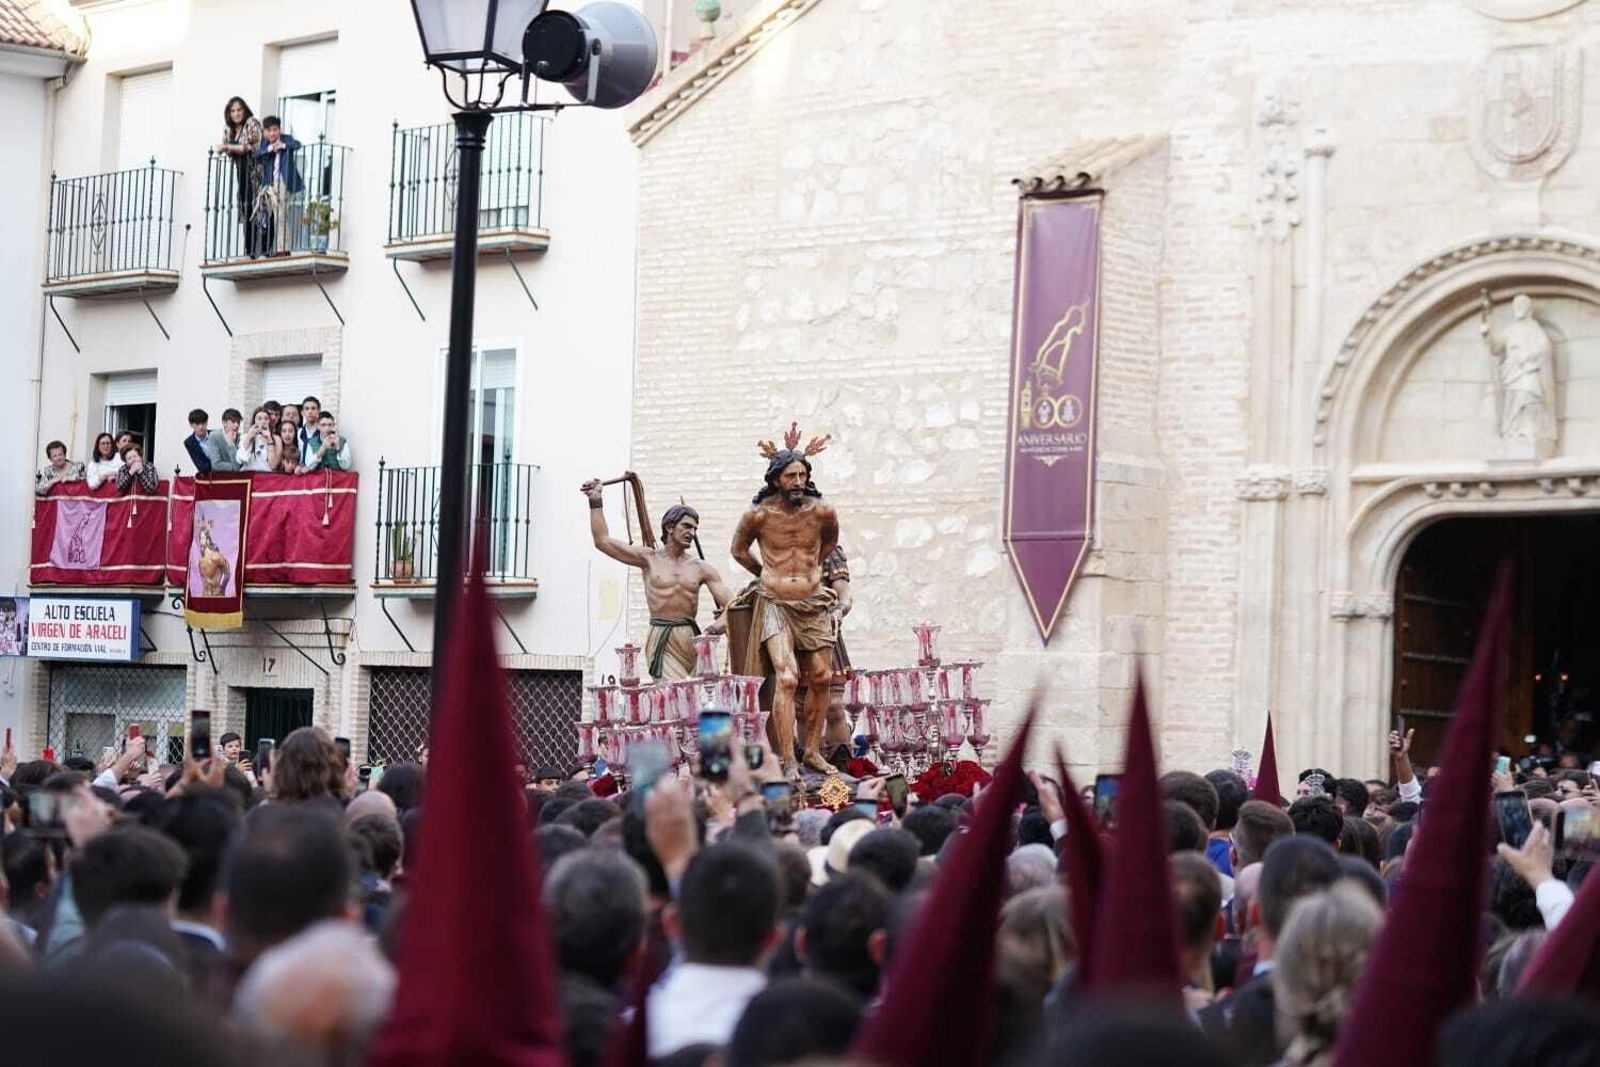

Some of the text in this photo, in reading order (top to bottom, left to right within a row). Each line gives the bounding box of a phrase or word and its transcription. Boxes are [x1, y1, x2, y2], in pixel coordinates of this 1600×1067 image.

[1017, 433, 1087, 446] ANIVERSARIO
[44, 604, 116, 621] AUTO ESCUELA
[31, 622, 127, 640] VIRGEN DE ARACELI
[31, 641, 50, 651] CENTRO
[52, 642, 60, 652] DE
[262, 657, 276, 673] 17
